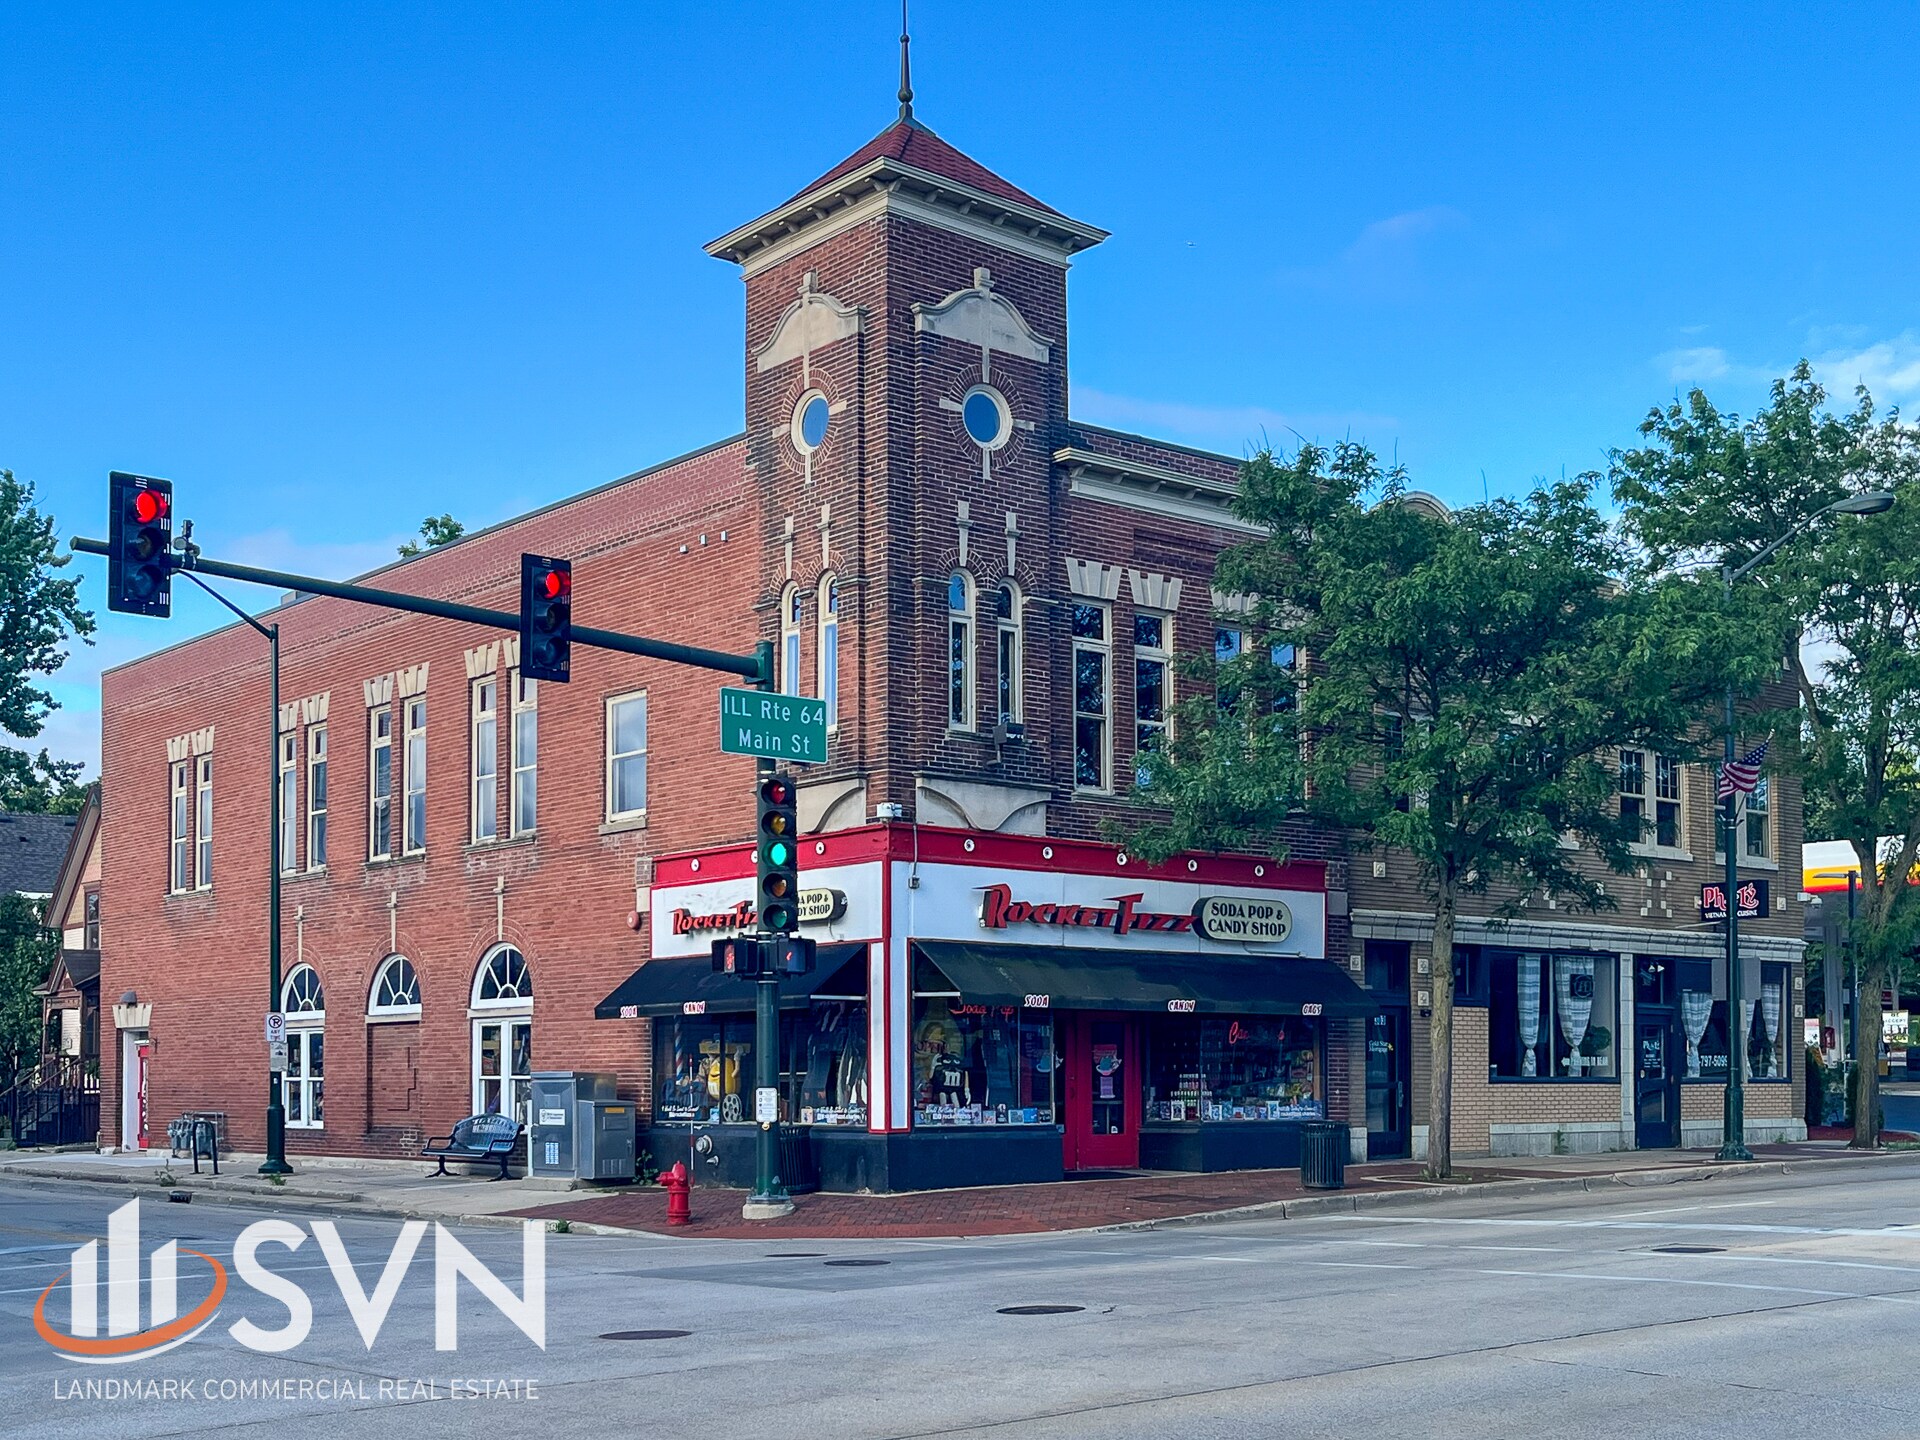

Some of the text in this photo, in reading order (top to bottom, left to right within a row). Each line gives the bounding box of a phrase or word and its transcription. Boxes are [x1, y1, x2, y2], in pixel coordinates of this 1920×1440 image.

[724, 695, 824, 726] ILL Rte 64
[739, 728, 810, 755] Main St
[806, 893, 823, 904] POP
[808, 904, 831, 916] SHOP
[1211, 902, 1284, 920] SODA POP &
[1208, 918, 1287, 937] CANDY SHOP
[683, 1001, 706, 1015] CANDY
[1024, 994, 1049, 1008] SODA
[1167, 999, 1196, 1013] CANDY
[620, 1005, 637, 1018] SODA
[1302, 1003, 1322, 1016] GAGS
